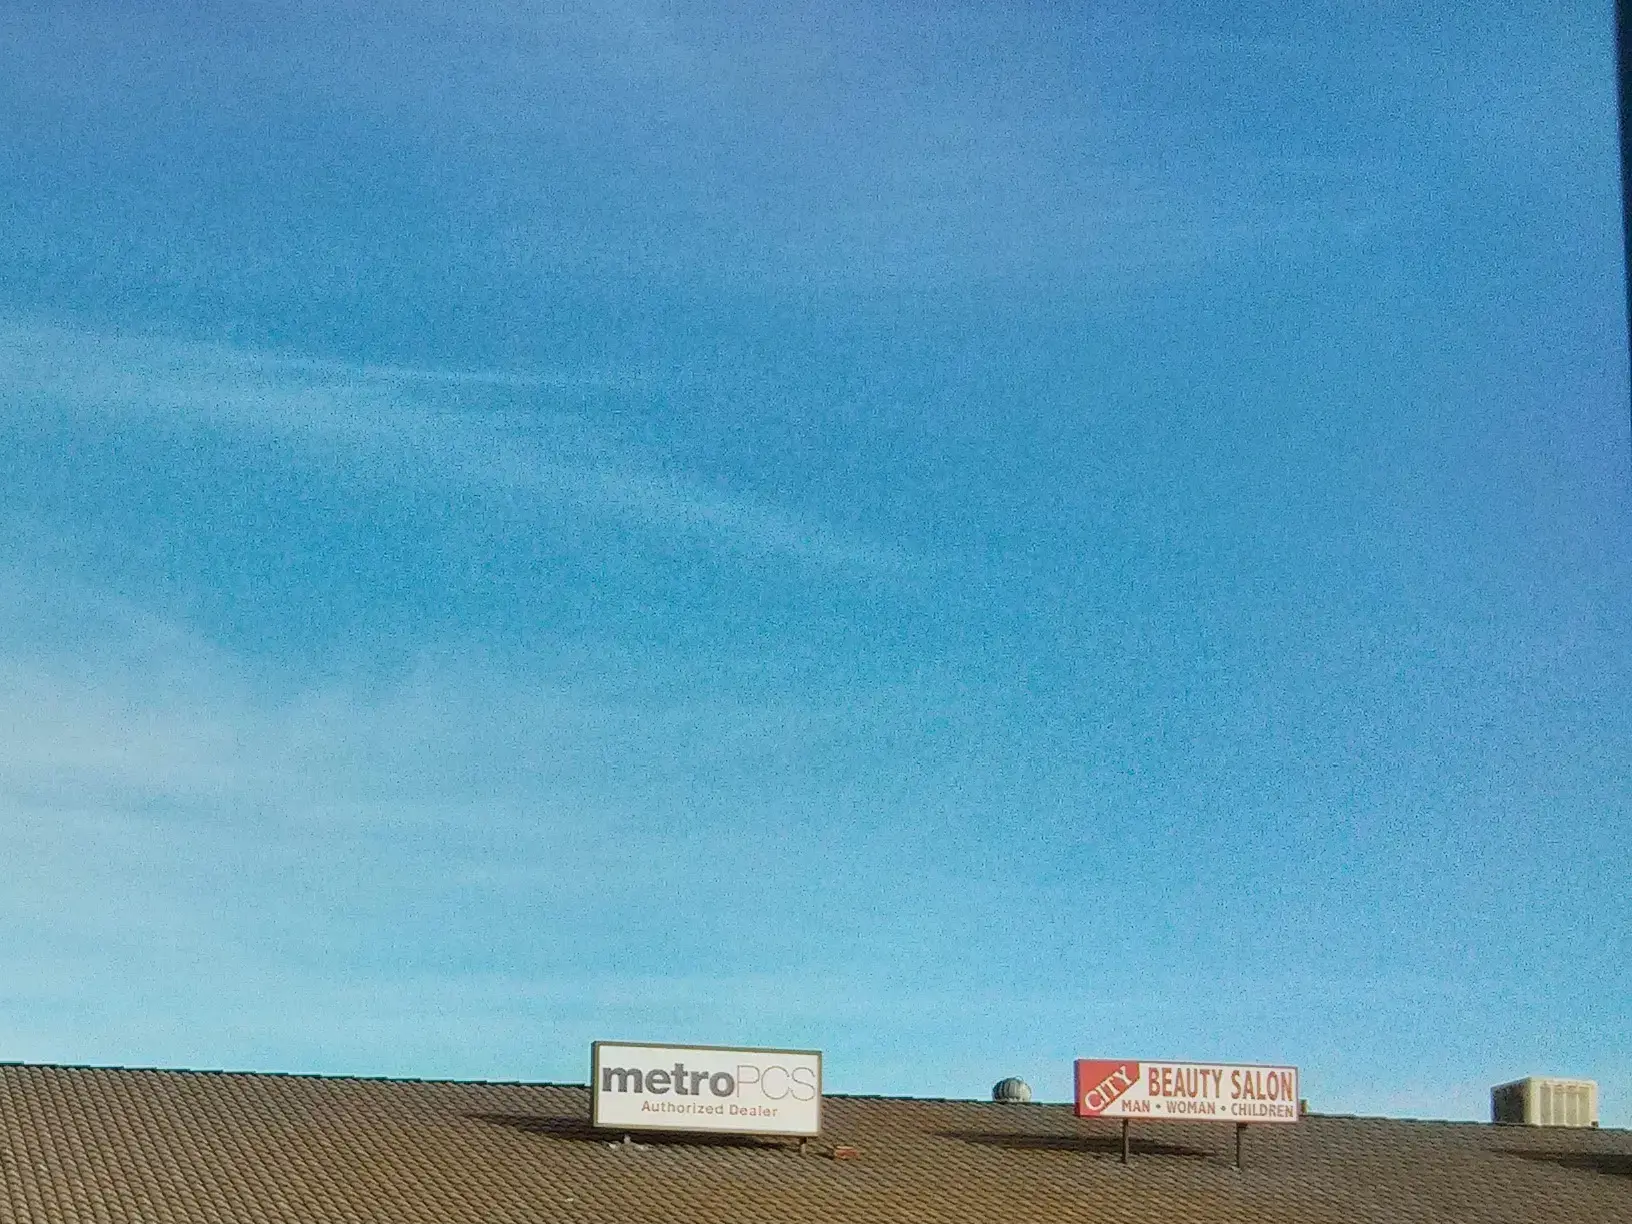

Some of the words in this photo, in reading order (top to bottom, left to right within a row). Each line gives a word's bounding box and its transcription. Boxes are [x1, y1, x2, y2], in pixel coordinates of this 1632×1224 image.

[602, 1062, 815, 1101] metroPCS
[1084, 1065, 1132, 1111] CITY
[1148, 1067, 1223, 1098] BEAUTY
[1231, 1070, 1293, 1101] SALON
[641, 1100, 724, 1115] Authorized
[730, 1104, 779, 1117] Dealer
[1122, 1100, 1150, 1113] MAN
[1167, 1101, 1216, 1114] WOMAN
[1231, 1103, 1293, 1117] CHILDREN
